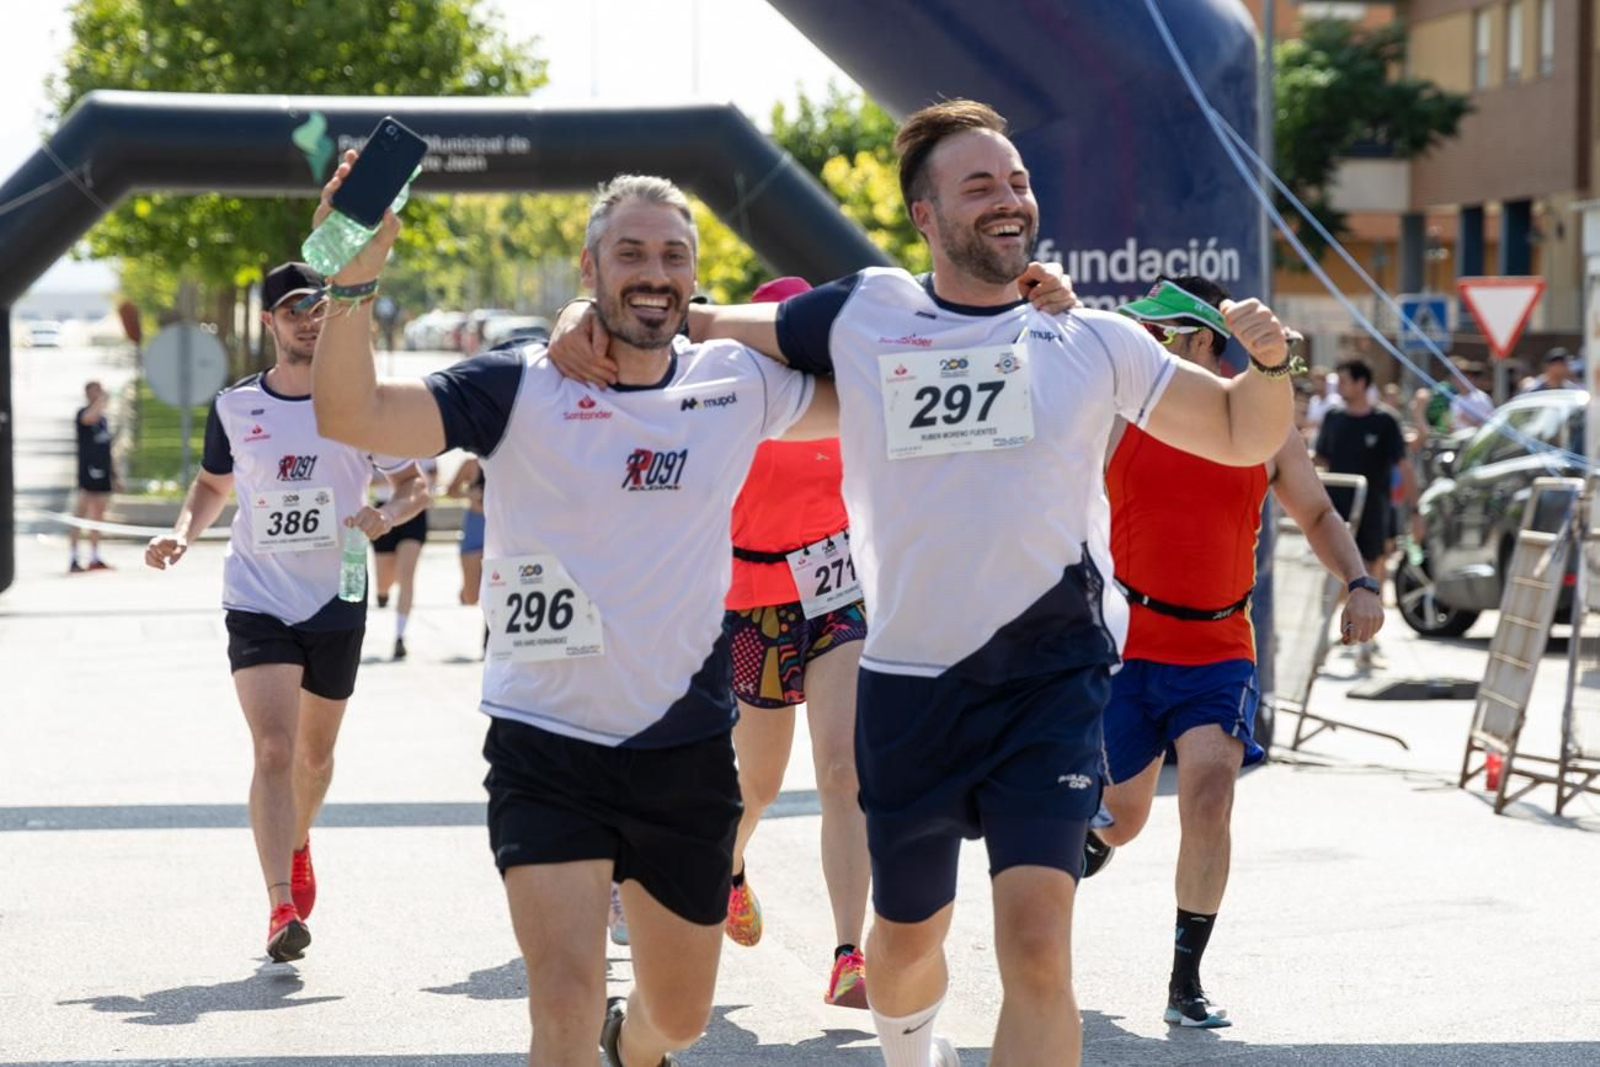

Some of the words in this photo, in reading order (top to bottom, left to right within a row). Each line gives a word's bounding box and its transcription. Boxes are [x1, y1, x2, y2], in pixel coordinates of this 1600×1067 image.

[506, 134, 531, 153] de
[703, 393, 738, 408] mupol
[908, 380, 1005, 429] 297
[563, 410, 613, 421] Santander
[267, 508, 320, 536] 386
[815, 553, 857, 597] 271
[505, 588, 575, 634] 296
